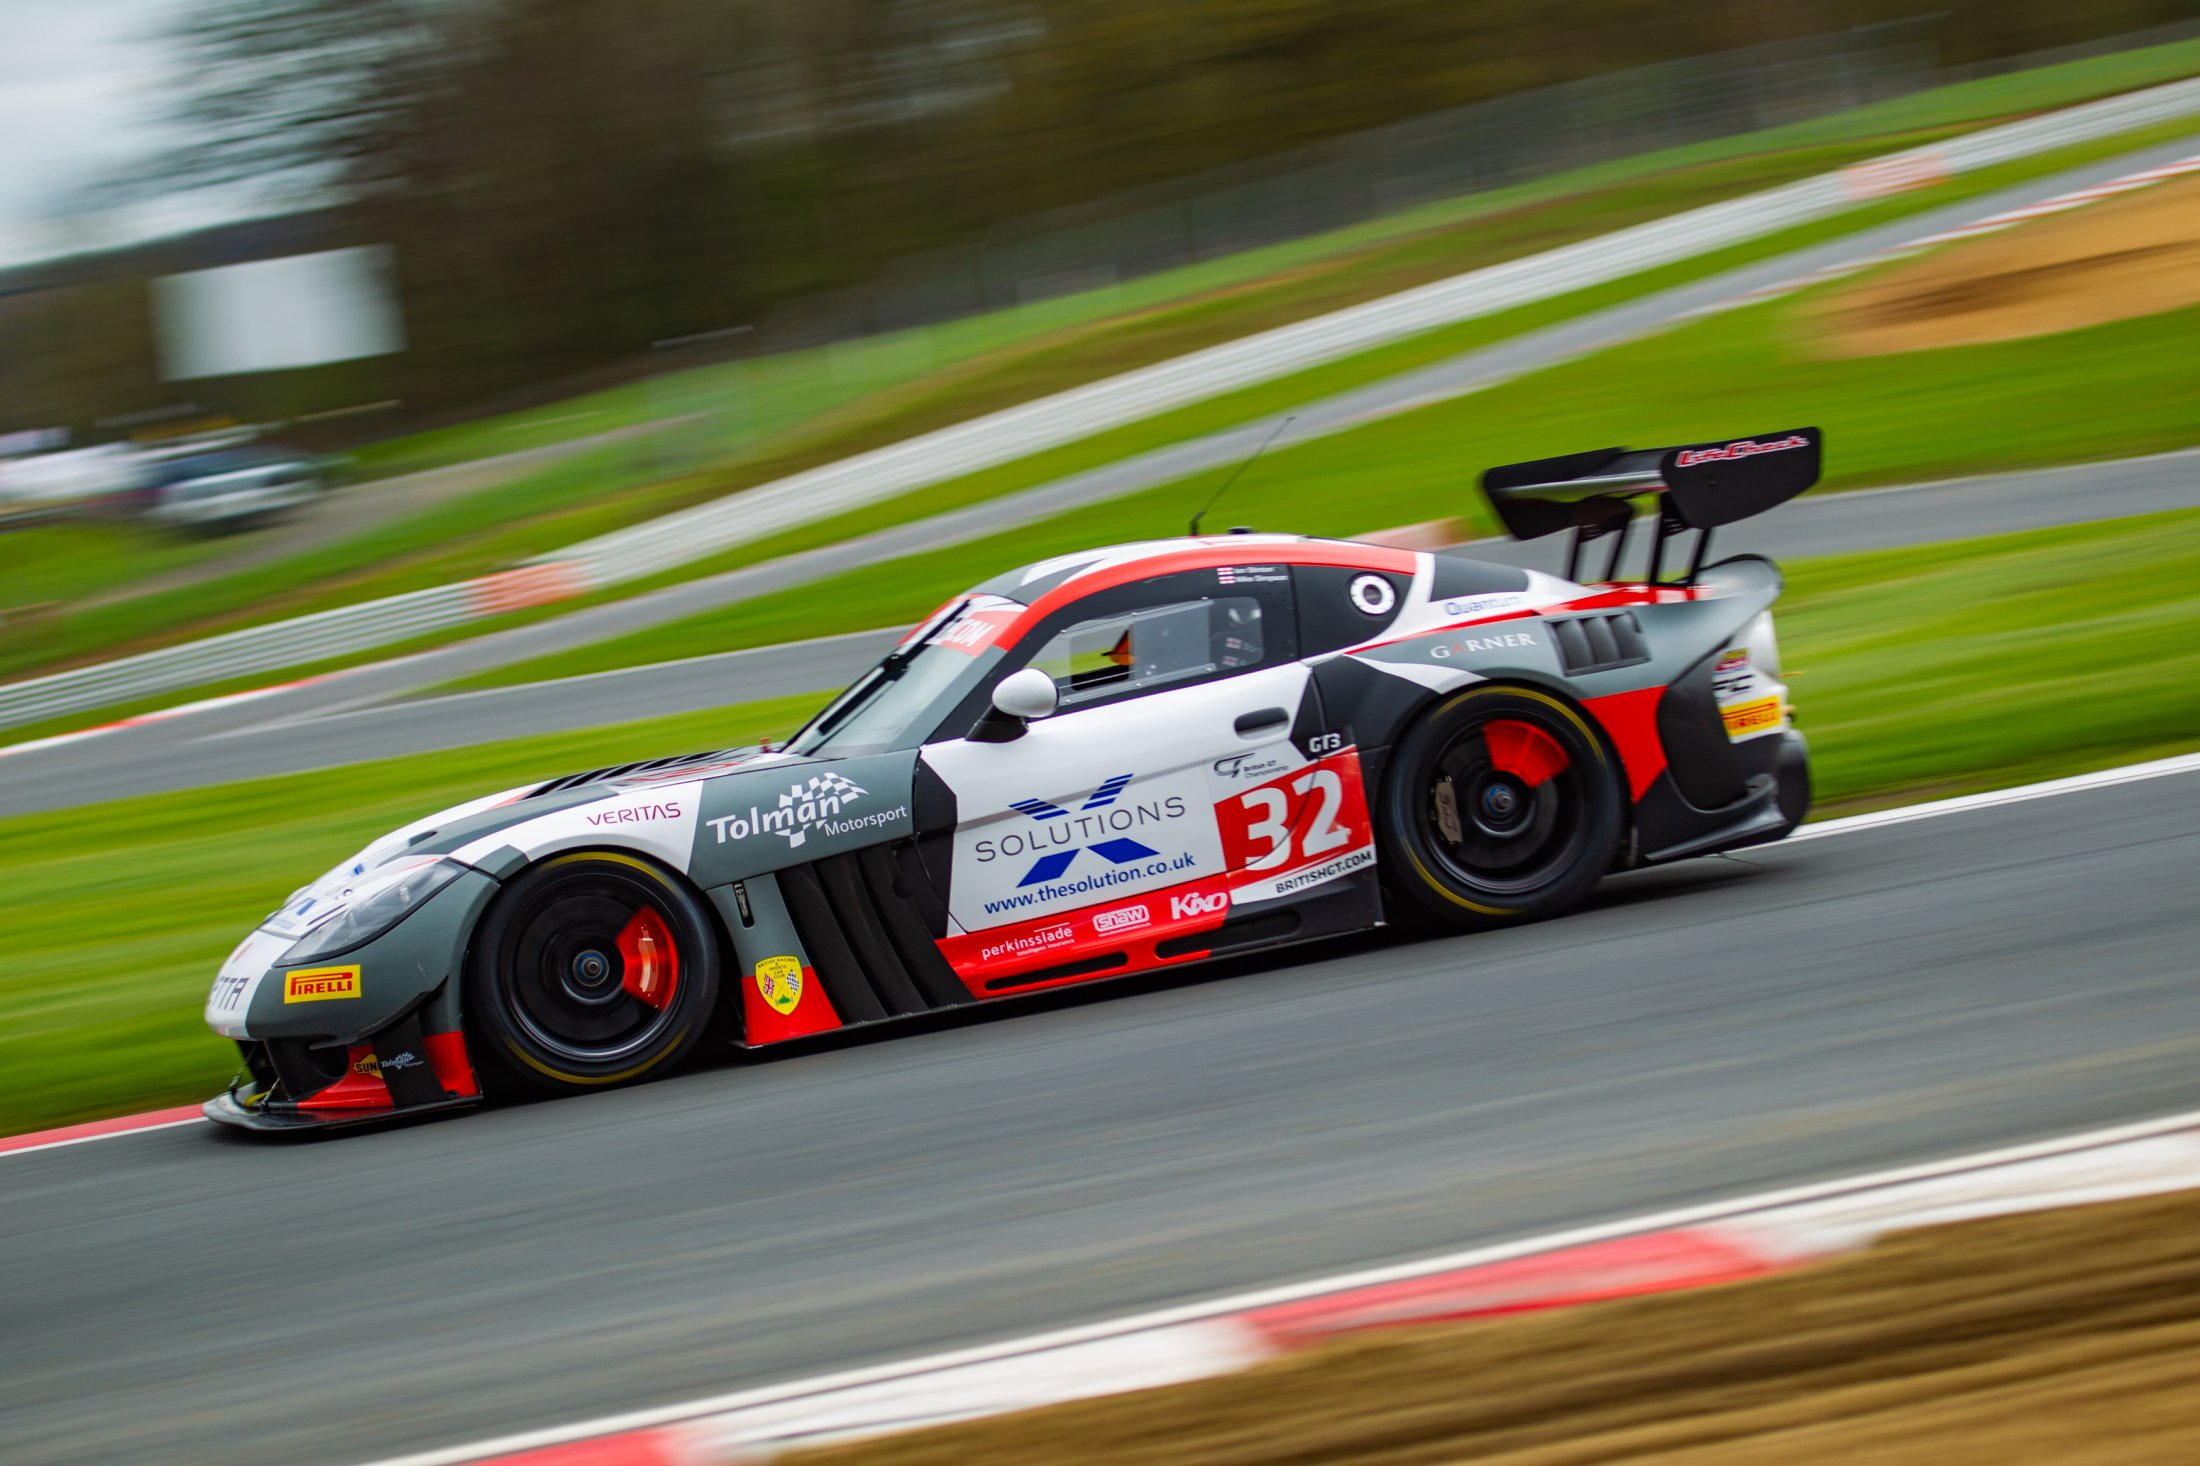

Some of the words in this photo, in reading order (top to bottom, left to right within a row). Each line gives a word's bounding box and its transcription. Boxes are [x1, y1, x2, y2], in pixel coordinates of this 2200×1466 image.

[1430, 633, 1538, 659] GARNER
[1309, 732, 1341, 753] GT3
[1243, 763, 1266, 773] British
[586, 802, 681, 826] VERITAS
[706, 794, 840, 845] Tolman
[824, 805, 908, 837] Motorsport
[975, 796, 1186, 863] SOLUTIONS
[1240, 769, 1352, 872] 32
[984, 852, 1196, 915] www.thesolution.co.uk
[1276, 850, 1373, 894] BRITISHGT.COM
[1170, 892, 1228, 920] Kixo
[981, 926, 1073, 961] perkinsslade
[289, 971, 353, 996] PIRELLI
